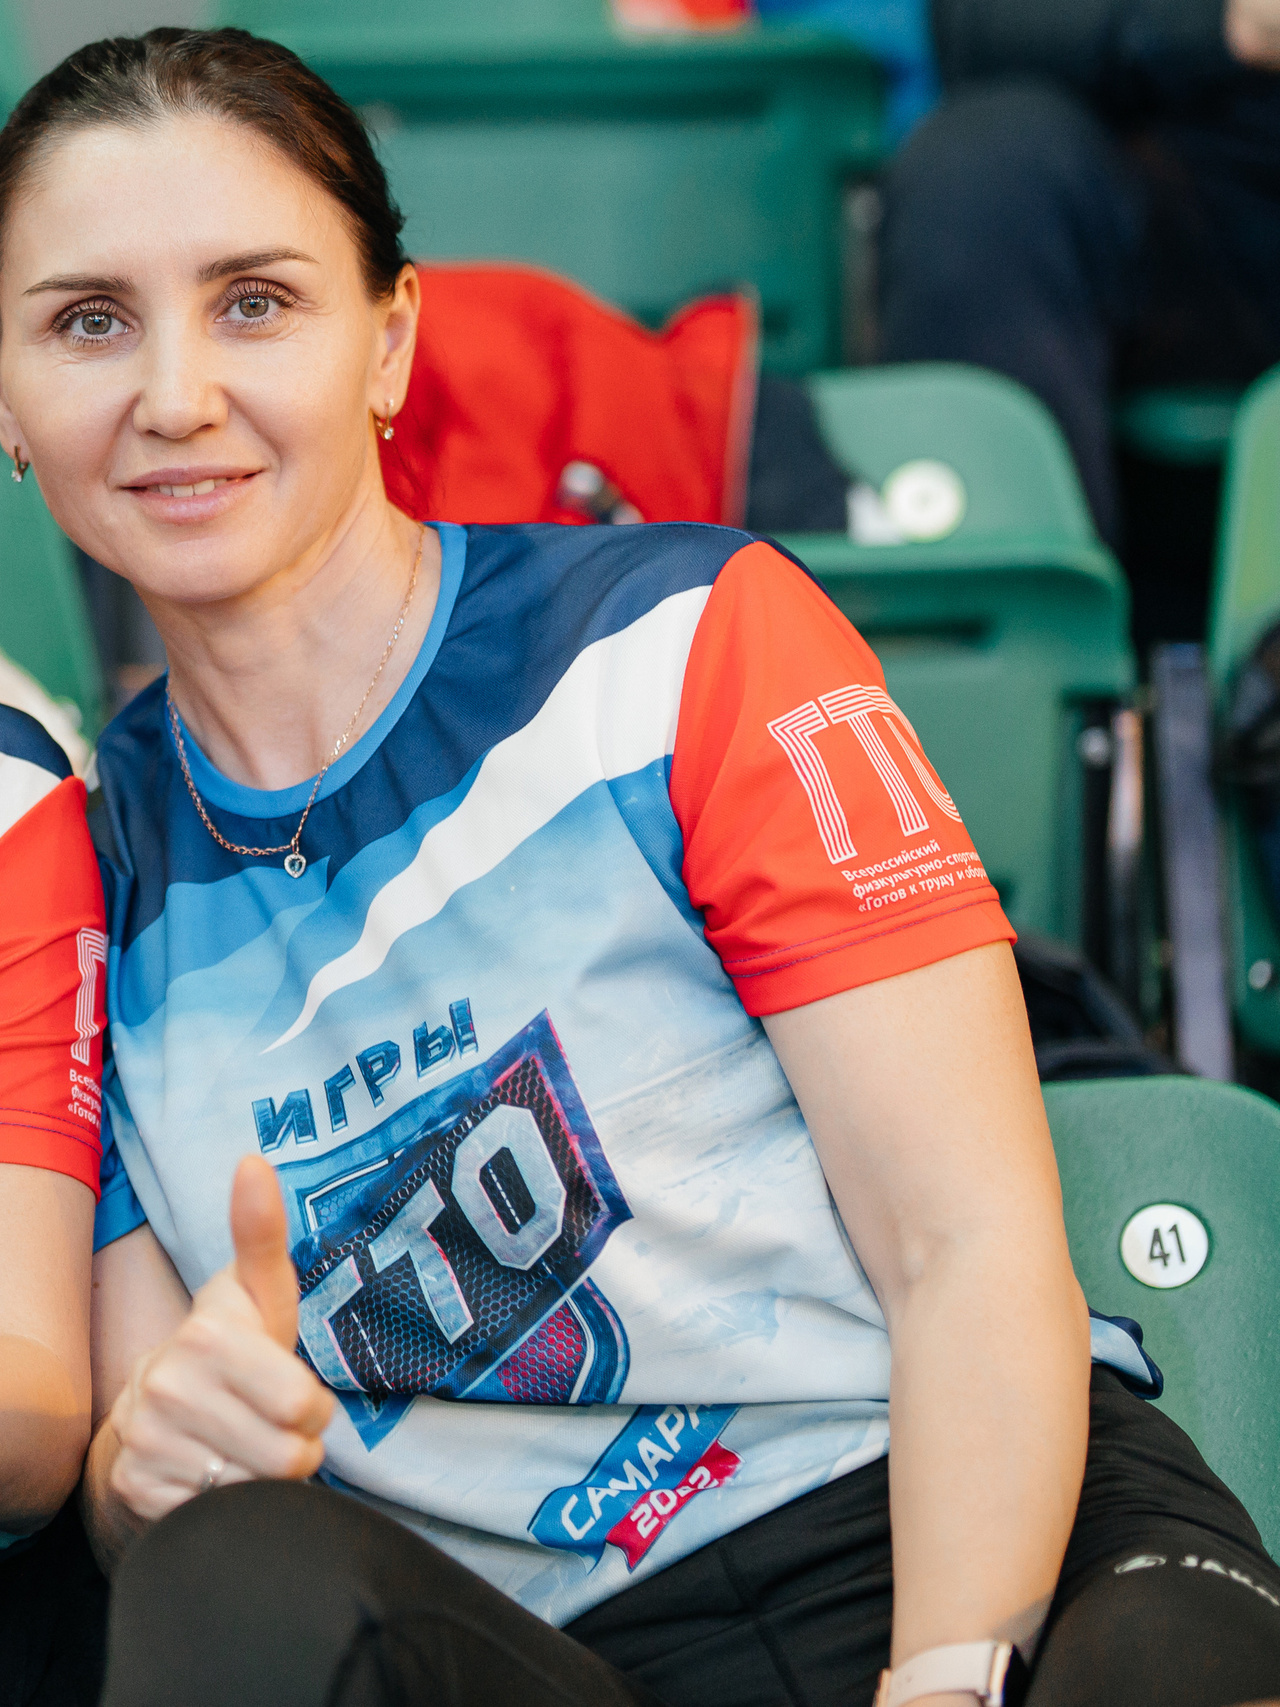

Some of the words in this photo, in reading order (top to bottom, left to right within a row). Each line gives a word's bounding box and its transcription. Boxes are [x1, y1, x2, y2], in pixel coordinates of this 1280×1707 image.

[841, 839, 941, 882] Всероссийский
[858, 888, 907, 912] «Готов
[909, 884, 918, 895] к
[919, 873, 955, 893] труду
[956, 870, 966, 881] и
[251, 997, 479, 1154] ИГРЫ
[1149, 1224, 1186, 1267] 41
